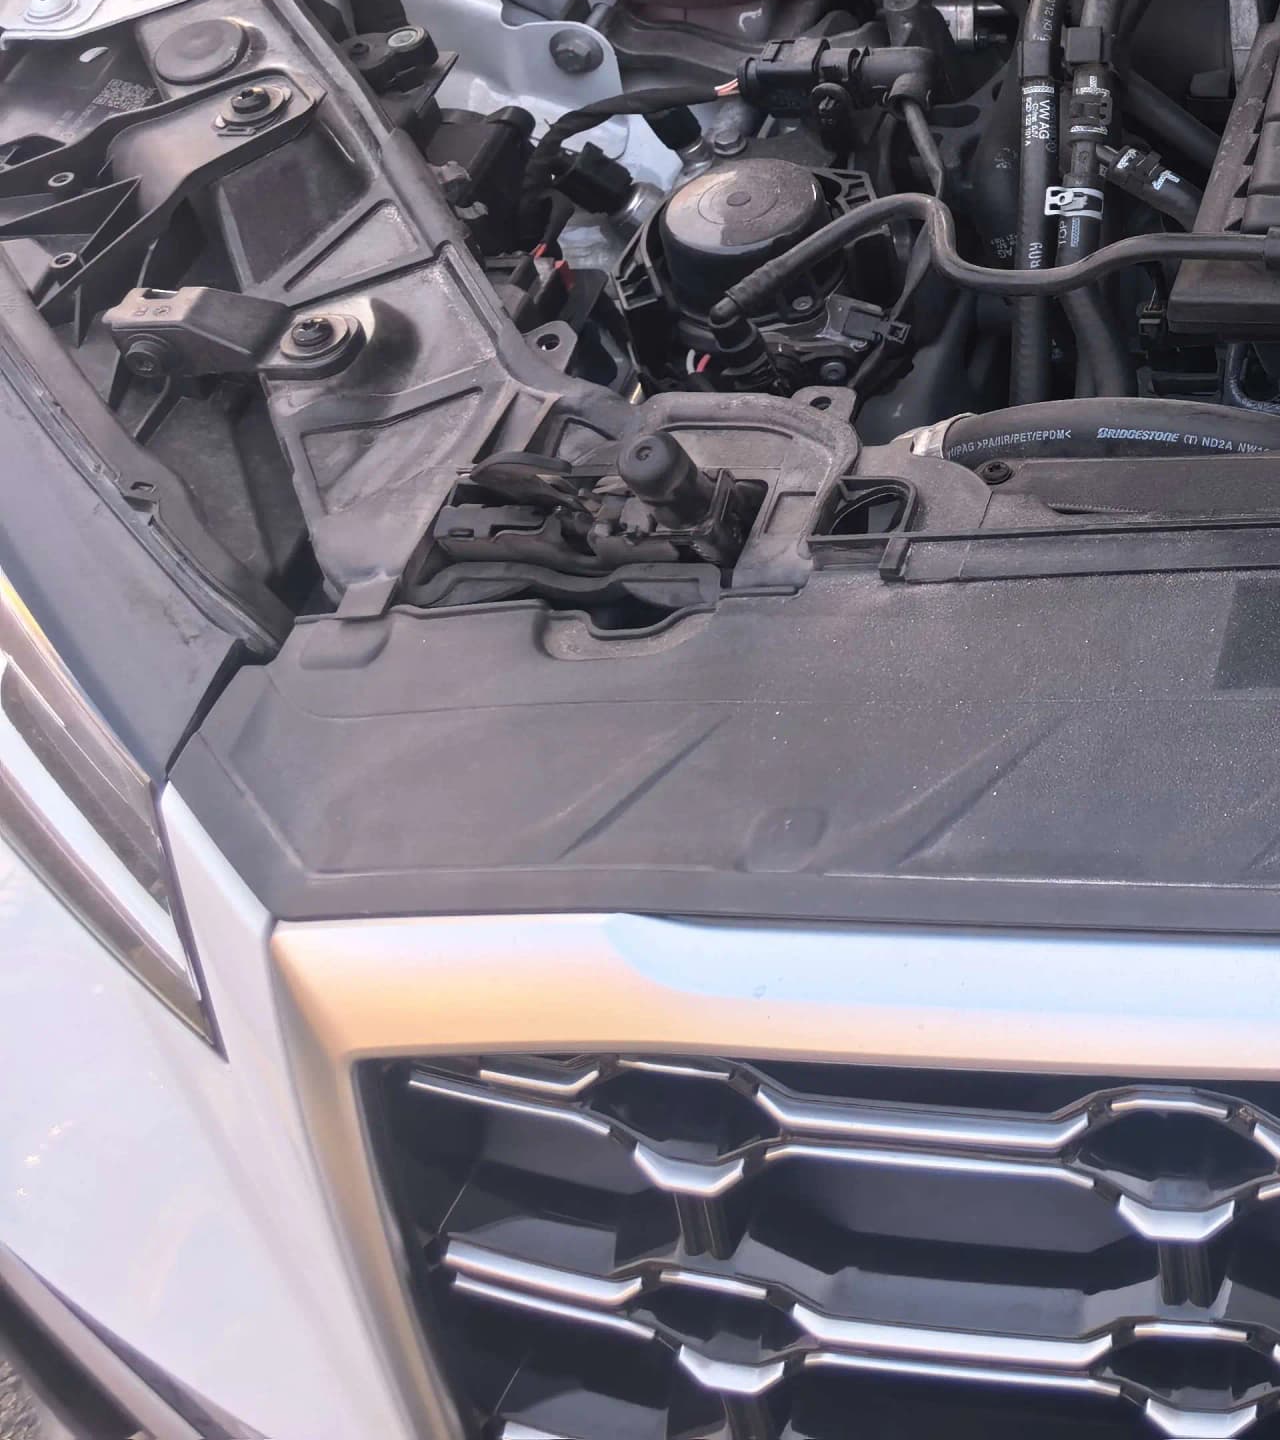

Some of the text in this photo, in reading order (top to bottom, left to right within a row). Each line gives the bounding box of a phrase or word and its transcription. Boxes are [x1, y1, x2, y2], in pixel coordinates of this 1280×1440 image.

[1038, 99, 1051, 140] VW AG
[1202, 436, 1233, 450] ND2A
